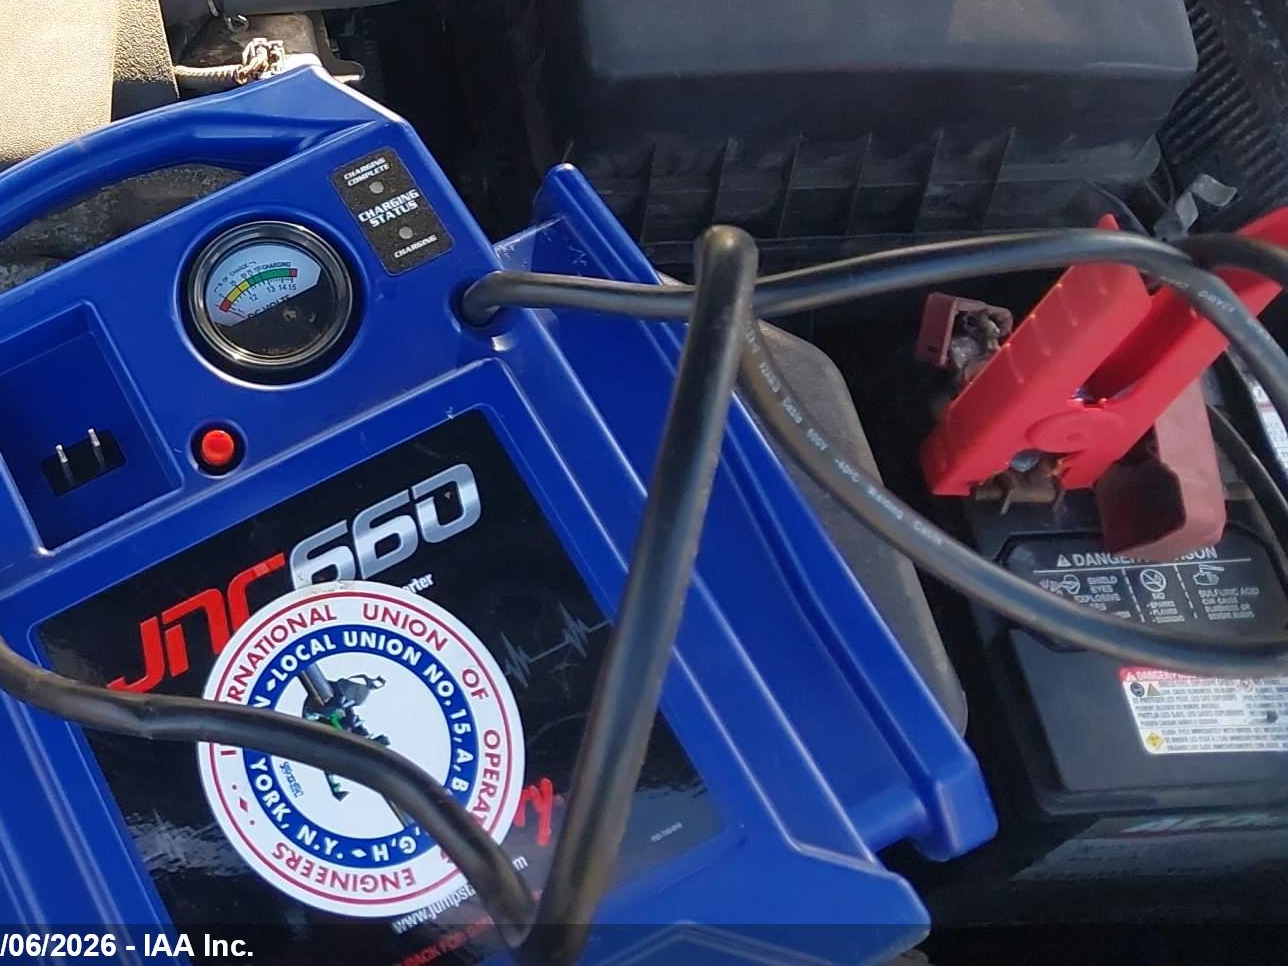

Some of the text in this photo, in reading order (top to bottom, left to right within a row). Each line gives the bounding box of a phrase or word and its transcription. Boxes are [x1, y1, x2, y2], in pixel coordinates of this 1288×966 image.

[343, 156, 387, 180] CHARGING
[347, 162, 391, 186] COMPLETE
[357, 188, 421, 223] CHARGING
[369, 199, 418, 228] STATUS
[394, 234, 438, 259] CHARGING
[248, 293, 259, 302] 12
[278, 283, 288, 291] 14
[288, 283, 297, 291] 15
[363, 602, 449, 652] UNION
[270, 634, 337, 683] LOCAL
[343, 630, 423, 667] UNION
[422, 662, 456, 707] NO.
[462, 668, 489, 700] OF
[250, 757, 293, 830] YORK,
[296, 824, 344, 860] N.Y.
[272, 841, 416, 894] ENGINEERS
